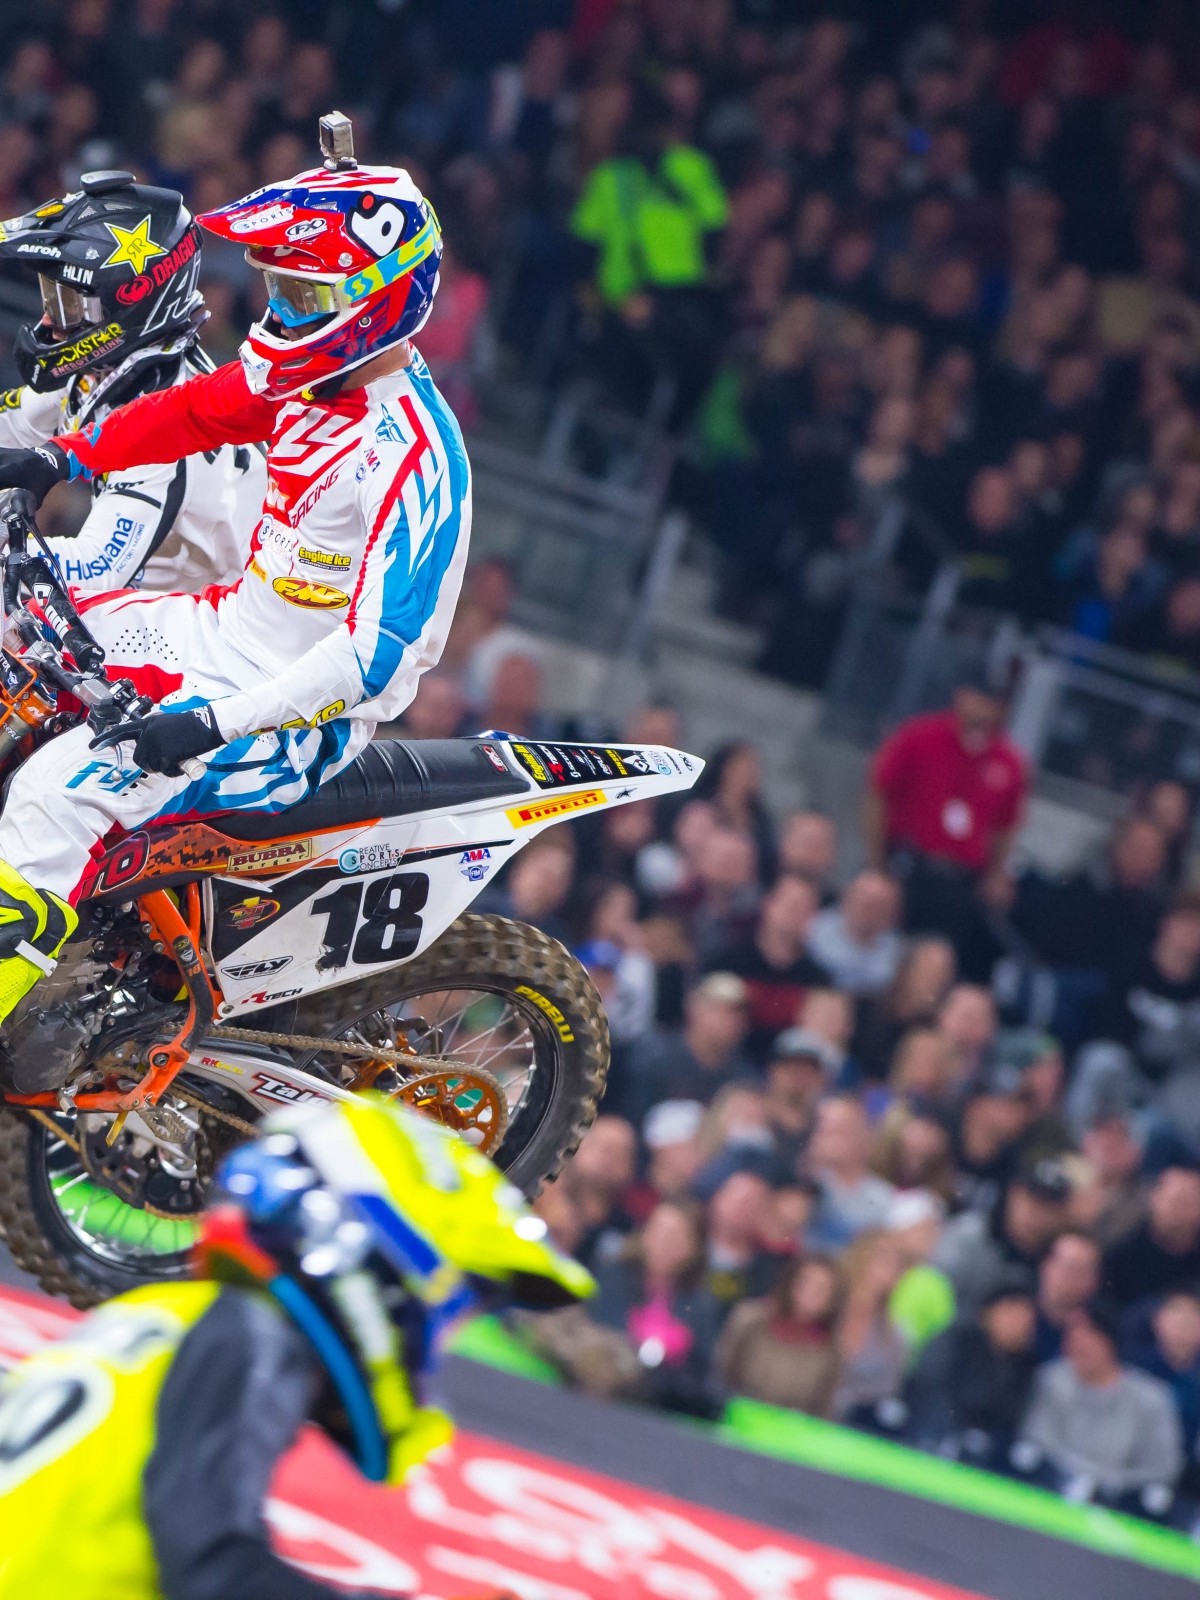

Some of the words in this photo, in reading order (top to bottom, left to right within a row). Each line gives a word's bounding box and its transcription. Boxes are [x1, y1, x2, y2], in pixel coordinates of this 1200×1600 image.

[91, 336, 126, 360] DRINK
[299, 547, 333, 565] Engine
[333, 553, 351, 566] Ice
[518, 792, 599, 822] PIRELLI
[232, 843, 306, 867] BUBBA
[459, 847, 492, 865] AMA
[311, 872, 430, 971] 18
[513, 984, 576, 1044] PIRELLI
